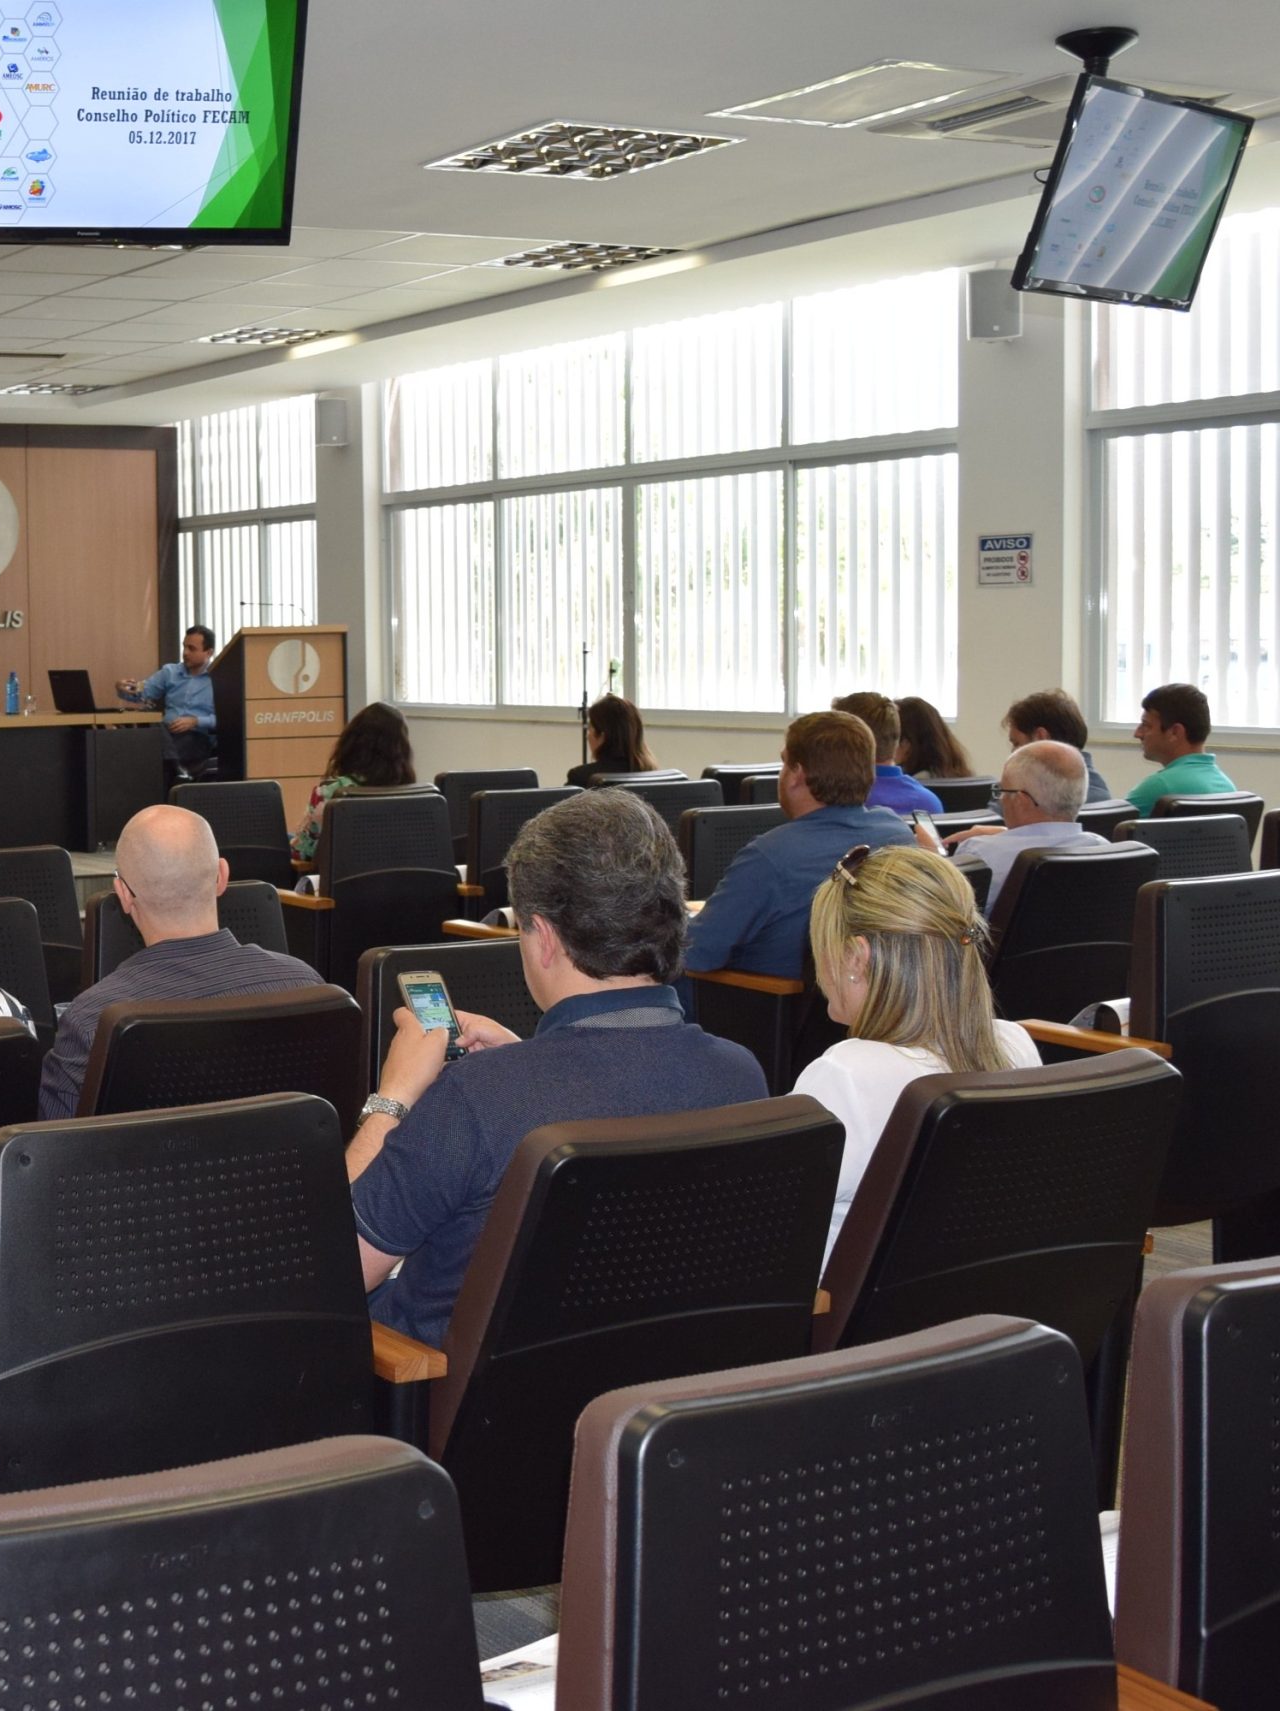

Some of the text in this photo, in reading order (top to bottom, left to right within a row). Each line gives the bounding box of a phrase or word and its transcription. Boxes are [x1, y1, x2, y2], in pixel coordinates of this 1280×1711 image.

[91, 86, 232, 102] Reunião de trabalho
[76, 108, 250, 124] Conselho Político FECAM
[128, 131, 197, 145] 05.12.2017
[984, 538, 1027, 549] AVISO
[255, 711, 335, 724] GRANFPOLIS
